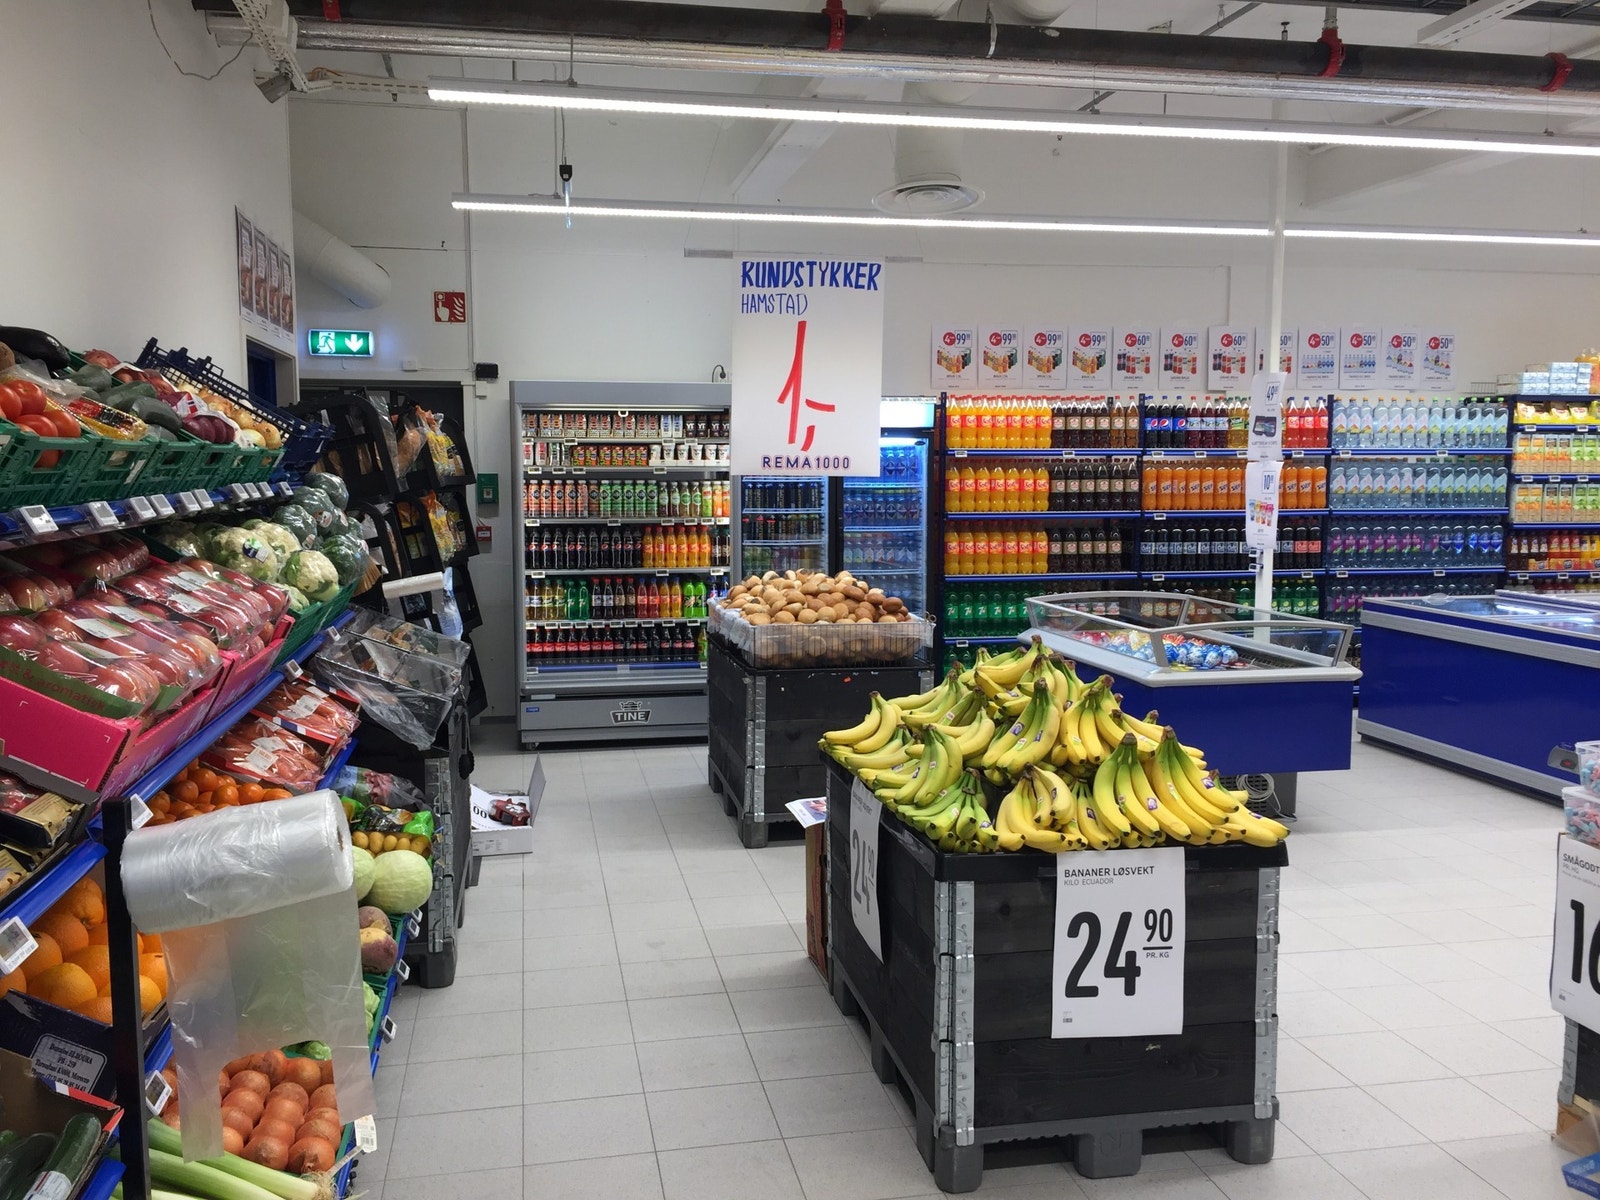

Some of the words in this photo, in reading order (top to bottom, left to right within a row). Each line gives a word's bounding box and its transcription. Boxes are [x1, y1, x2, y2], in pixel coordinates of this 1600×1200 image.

[741, 260, 881, 291] RUNDSTYKKER
[741, 293, 808, 315] HAMSTAD
[614, 711, 646, 721] TINE
[1064, 867, 1111, 878] BANANER
[1112, 865, 1155, 876] LØSVEKT
[1064, 878, 1080, 886] KILO
[1082, 877, 1114, 886] ECUADOR
[1065, 911, 1141, 998] 24
[1144, 908, 1173, 942] 90
